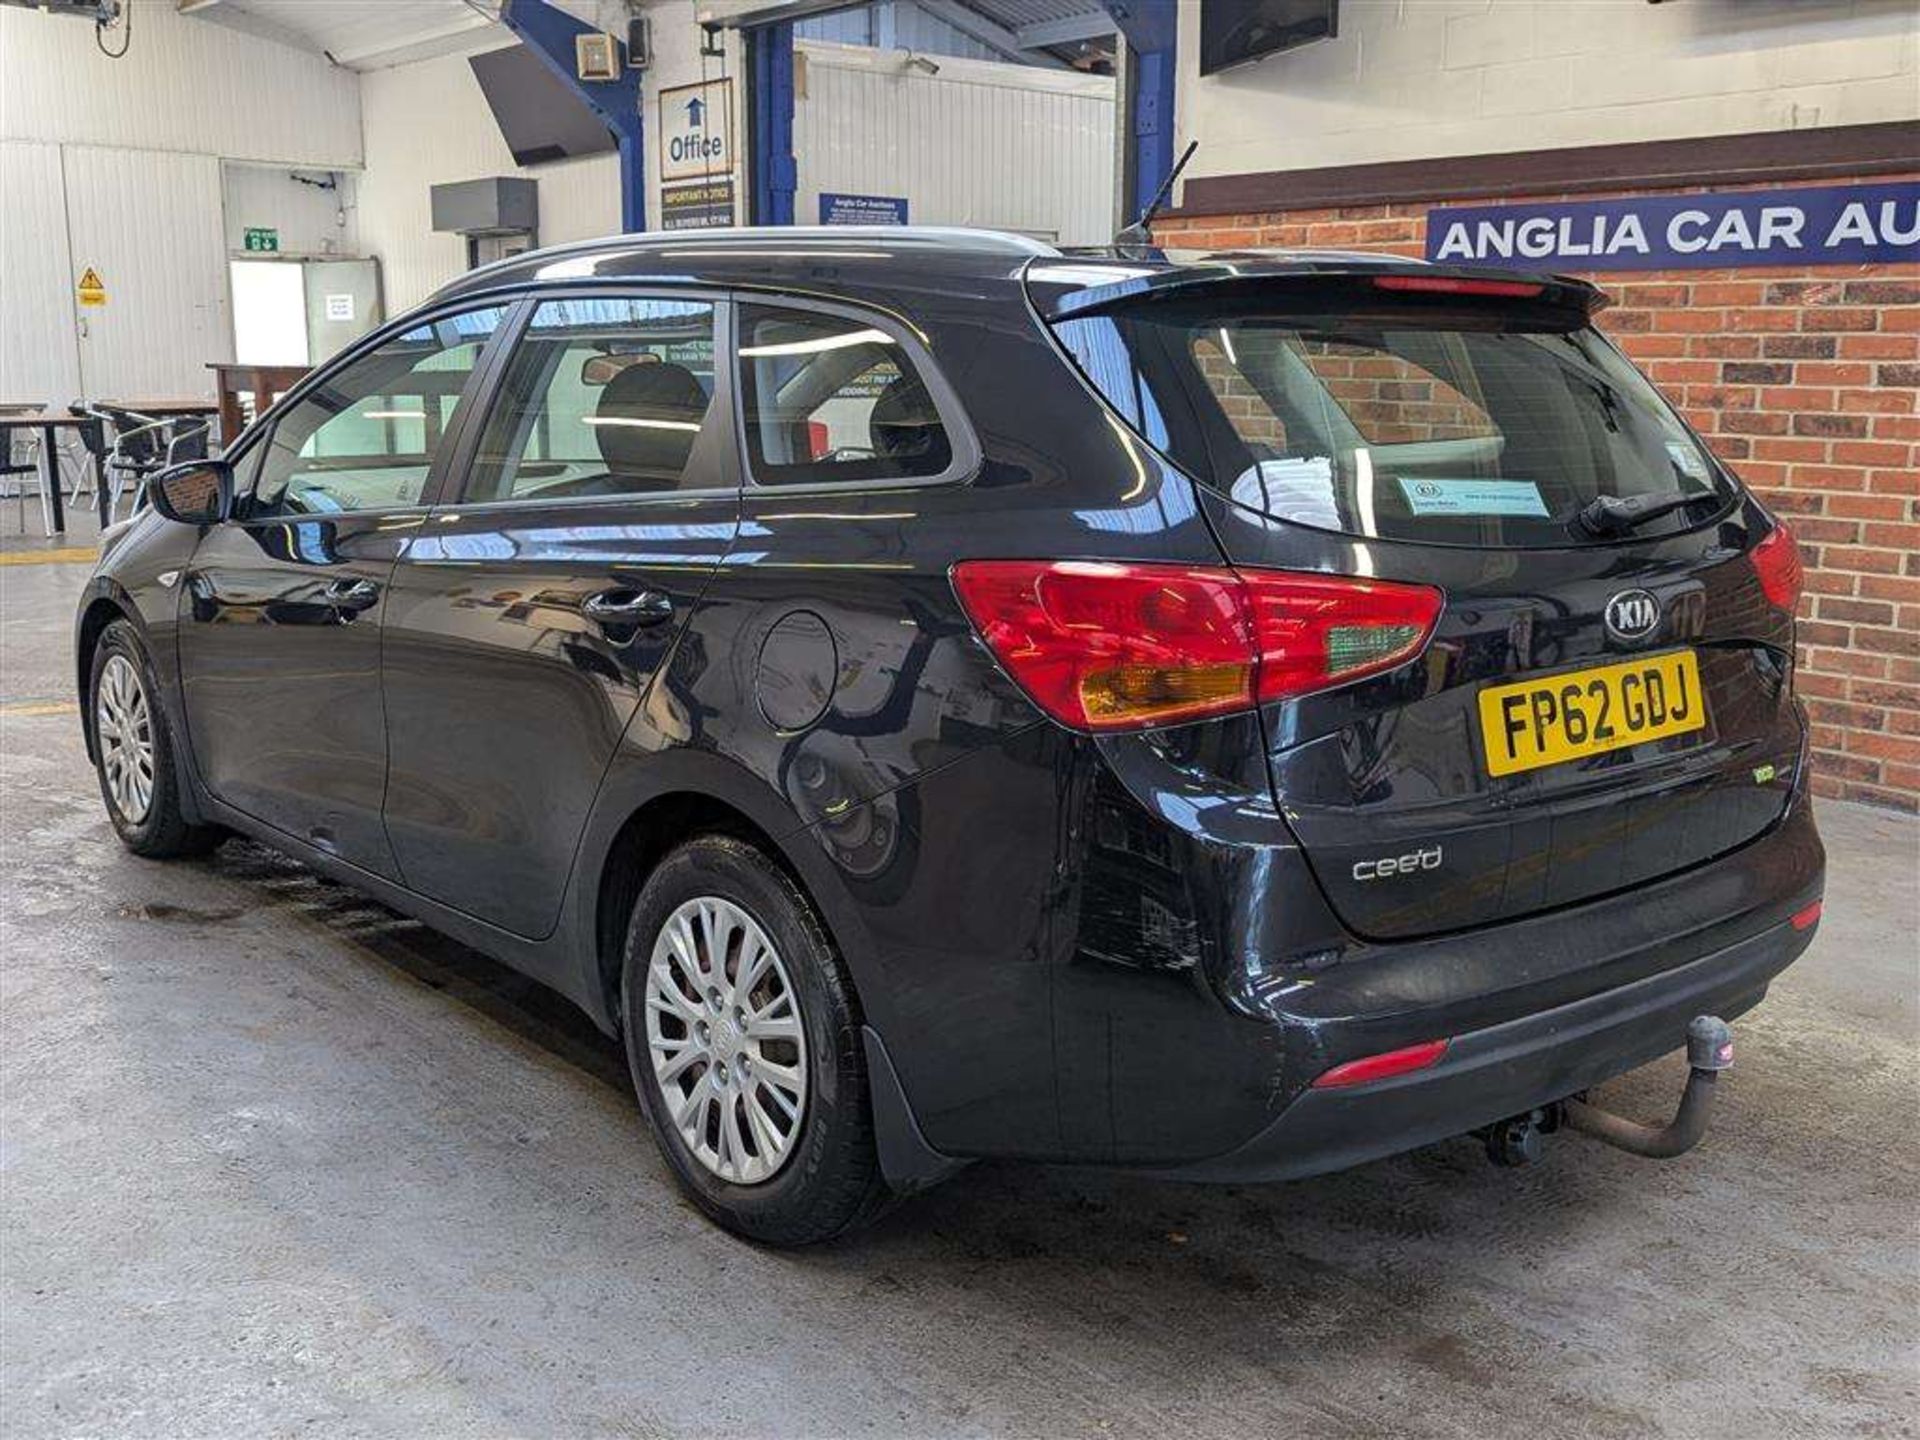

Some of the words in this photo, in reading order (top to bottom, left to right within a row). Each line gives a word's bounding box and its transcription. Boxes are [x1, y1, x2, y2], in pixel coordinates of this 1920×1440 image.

[670, 134, 722, 162] Office
[1436, 213, 1650, 260] ANGLIA
[1665, 205, 1806, 253] CAR
[1617, 601, 1655, 631] KIA
[1501, 679, 1614, 760] FP62
[1620, 662, 1690, 733] GDJ
[1352, 844, 1443, 882] cee'd
